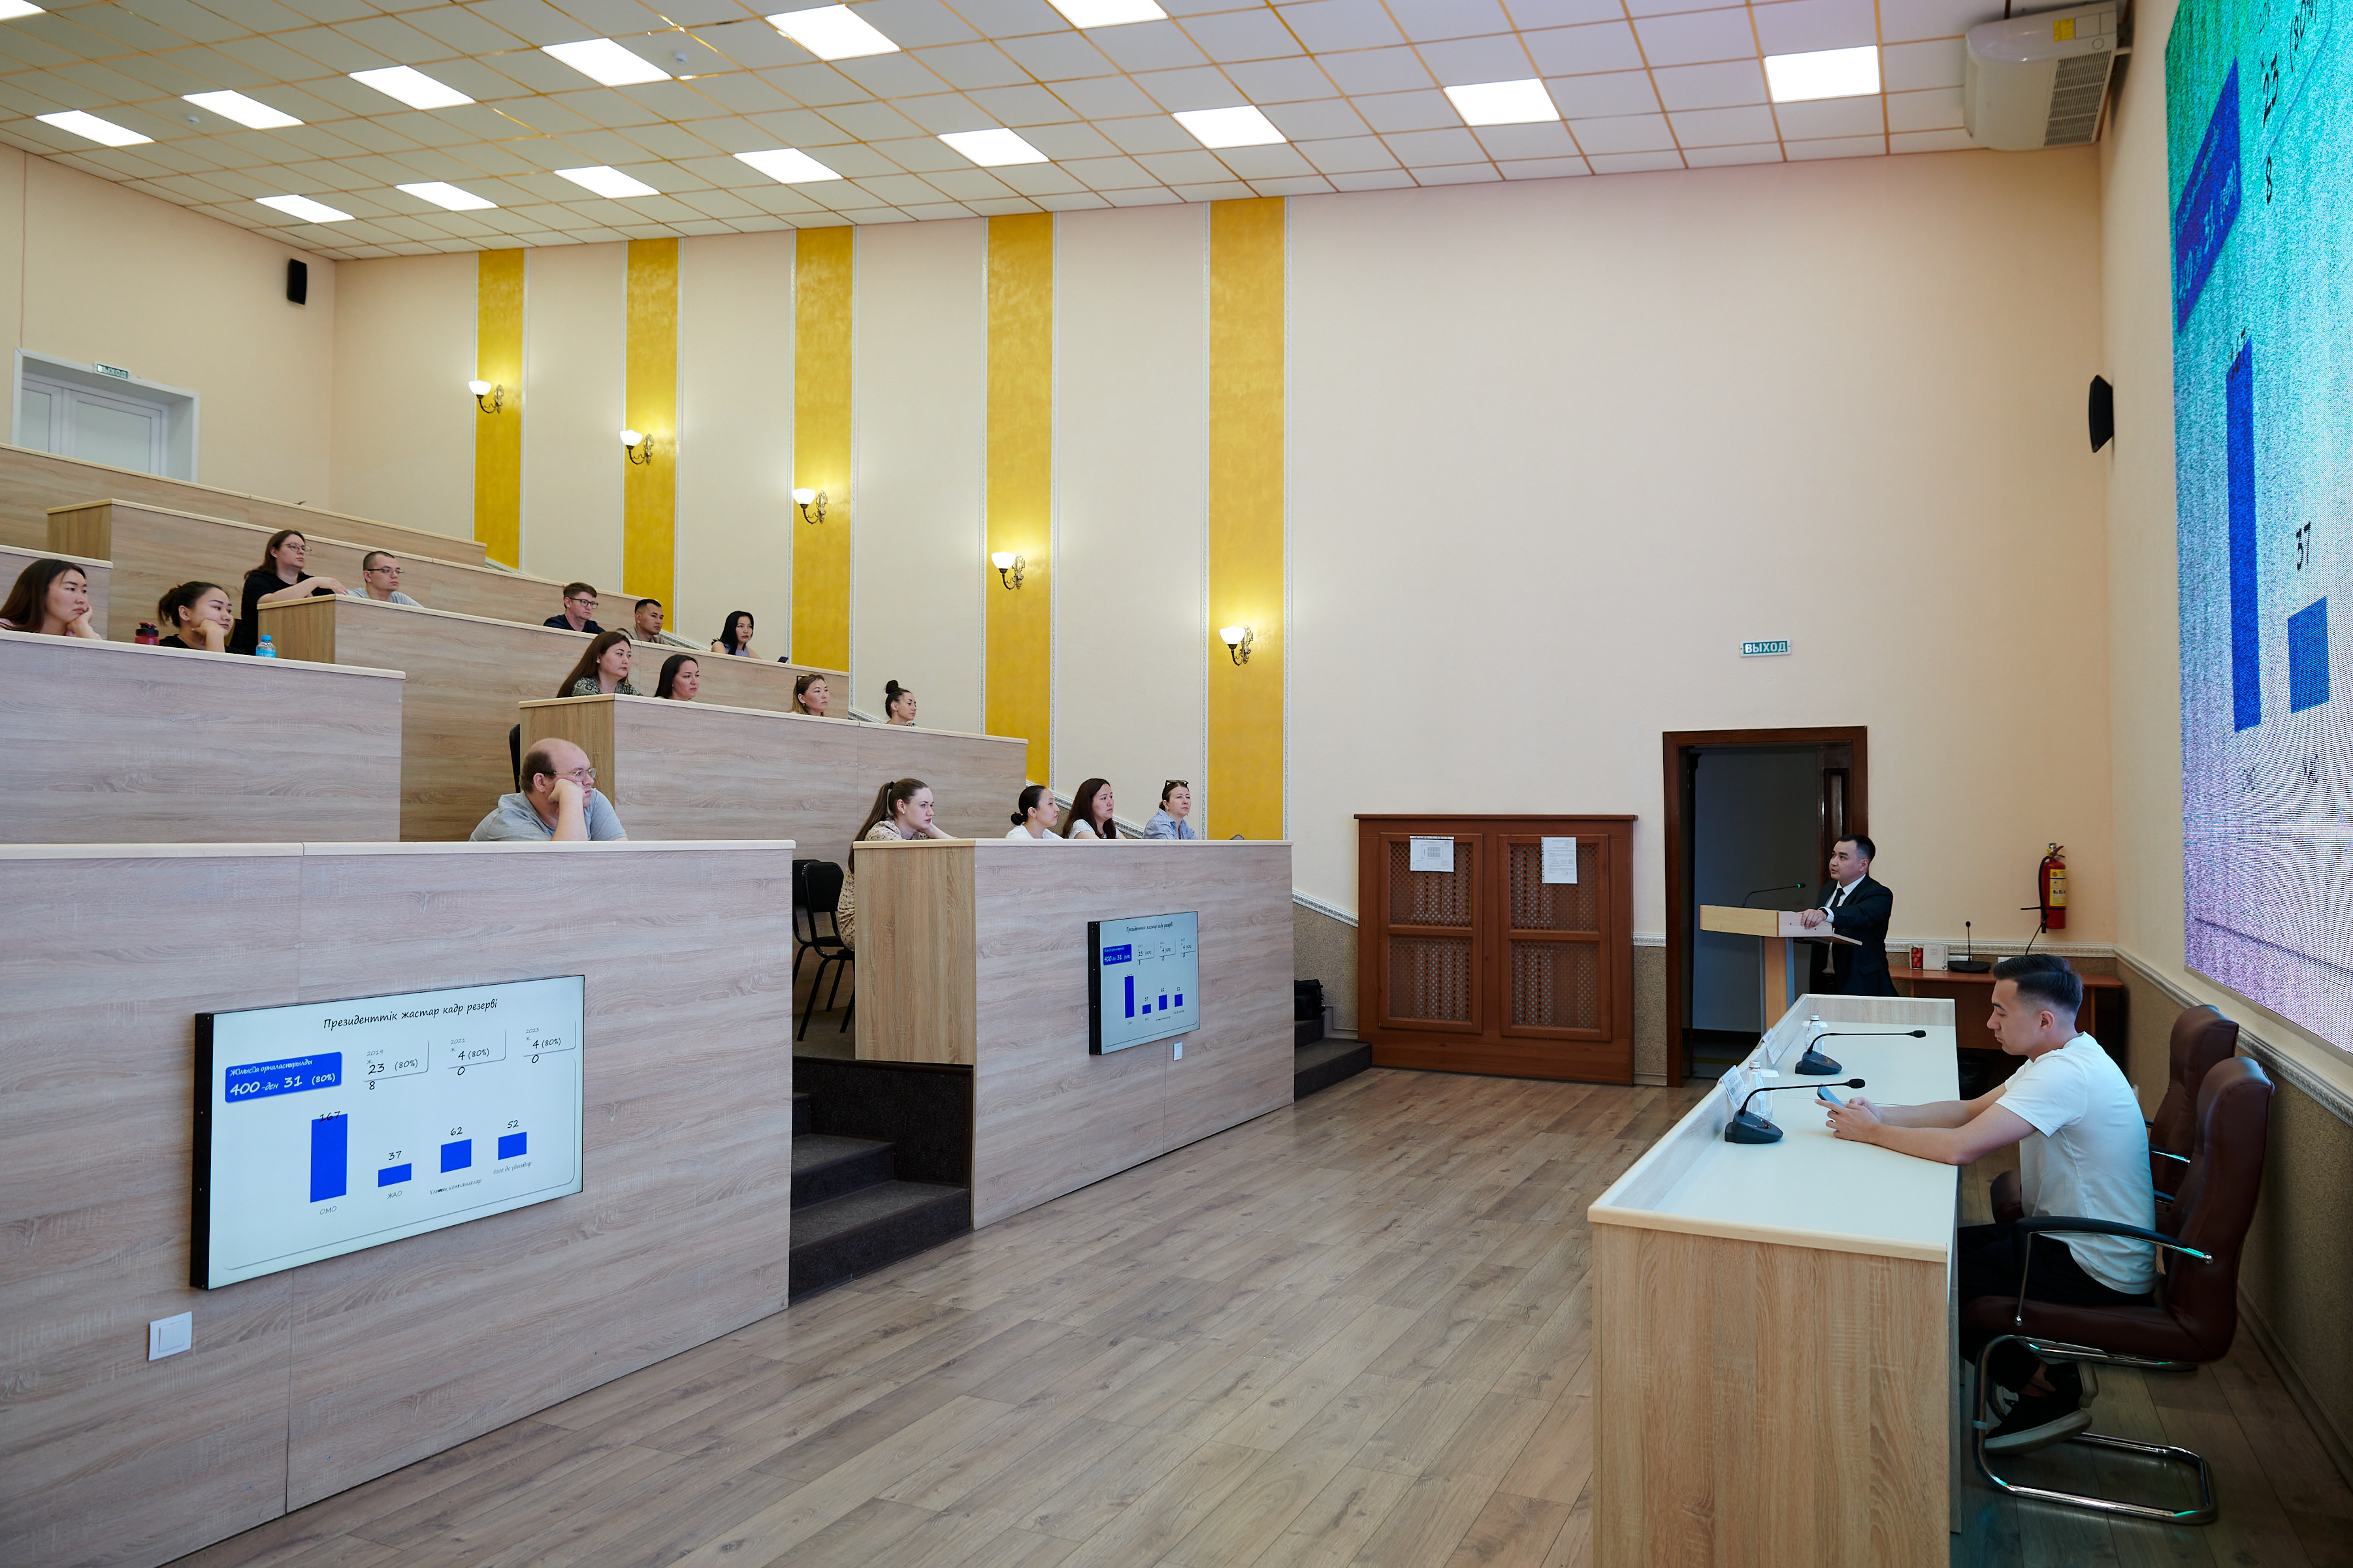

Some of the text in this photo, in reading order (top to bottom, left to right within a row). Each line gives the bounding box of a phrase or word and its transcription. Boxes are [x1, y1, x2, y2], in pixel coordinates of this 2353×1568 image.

[97, 364, 127, 379] ВЫХОД
[2296, 520, 2311, 571] 37
[1745, 642, 1786, 653] ВЫХОД
[323, 999, 498, 1031] Президенттік жастар кадр резерві
[532, 1037, 561, 1049] 4 (80%)
[458, 1048, 489, 1061] 4 (80%)
[368, 1059, 418, 1075] 23 (80%)
[284, 1076, 302, 1089] 31
[312, 1073, 336, 1085] (80%)
[369, 1081, 376, 1090] 8
[319, 1111, 340, 1123] 167
[507, 1120, 519, 1128] 52
[450, 1127, 463, 1136] 62
[389, 1151, 402, 1160] 37
[387, 1191, 402, 1200] ЖАО
